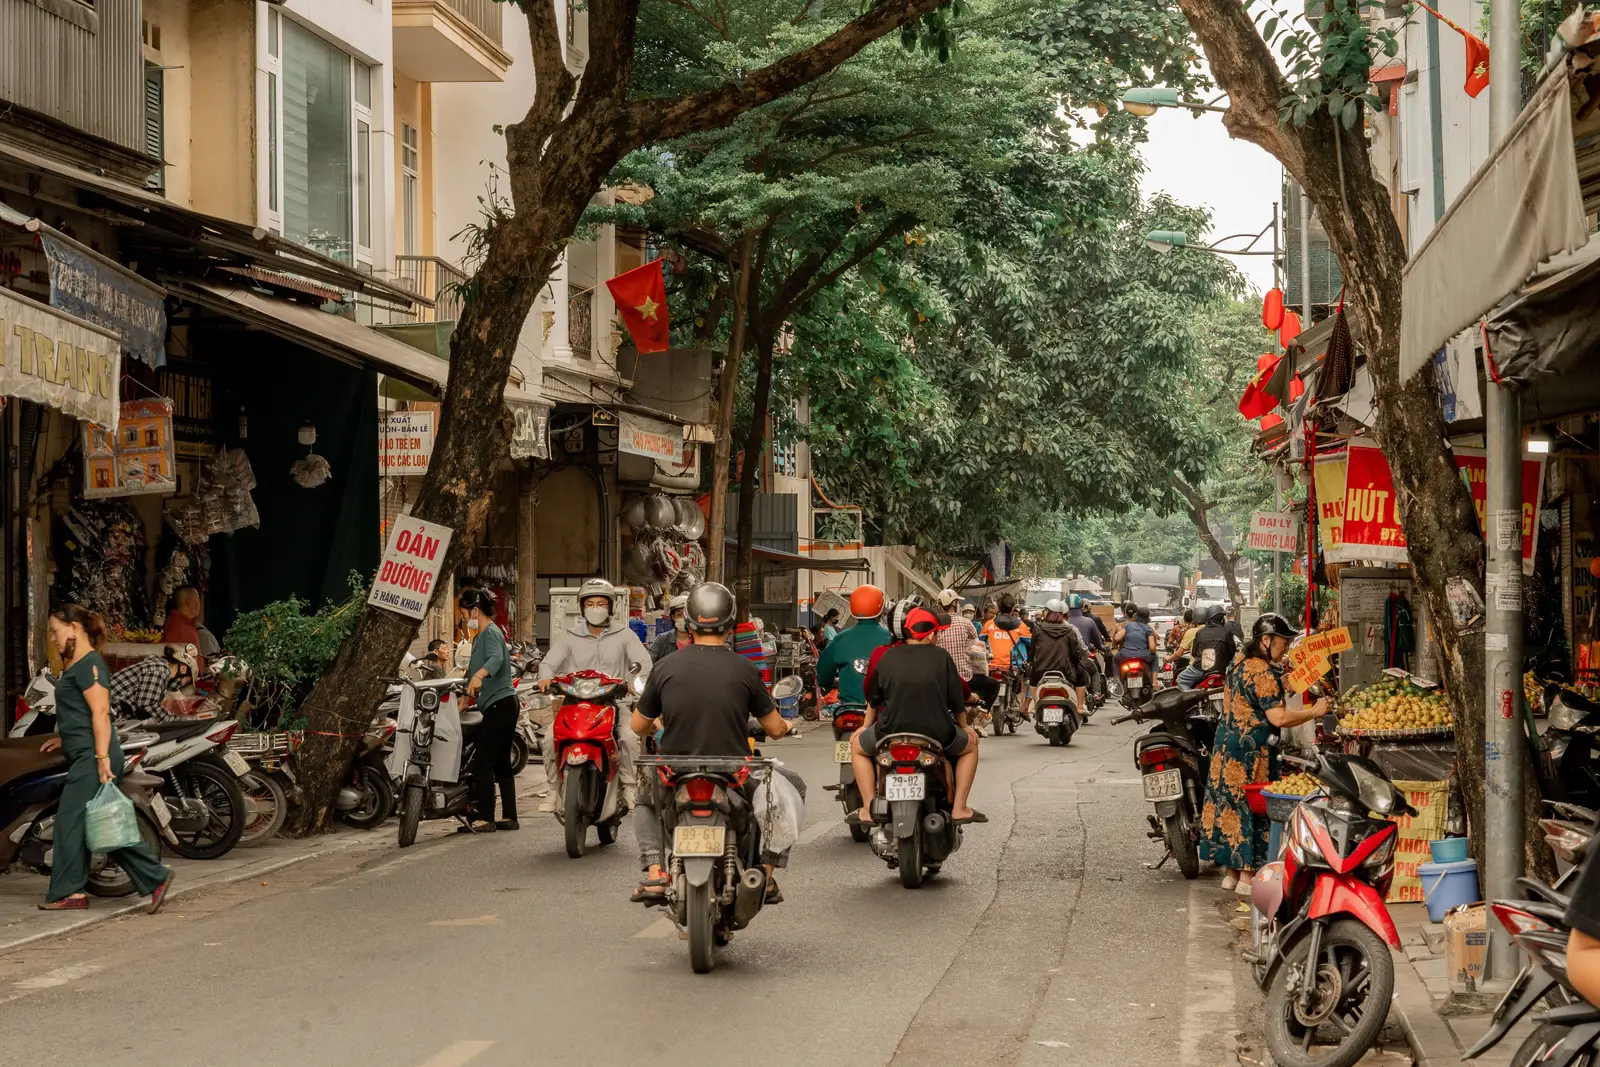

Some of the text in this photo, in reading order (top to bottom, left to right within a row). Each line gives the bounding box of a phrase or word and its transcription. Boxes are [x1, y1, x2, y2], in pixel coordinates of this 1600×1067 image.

[14, 324, 112, 400] TRANG
[410, 438, 421, 449] EM
[1322, 498, 1344, 519] HÚ
[1346, 483, 1389, 523] HÚT
[1258, 517, 1277, 529] ĐẠI
[396, 526, 440, 561] OẢN
[380, 560, 433, 595] ĐƯỜNG
[373, 589, 423, 613] 5 HÀNG KHOAI
[836, 752, 852, 762] 187
[888, 787, 922, 799] 511.52
[1397, 835, 1431, 854] KHÔN
